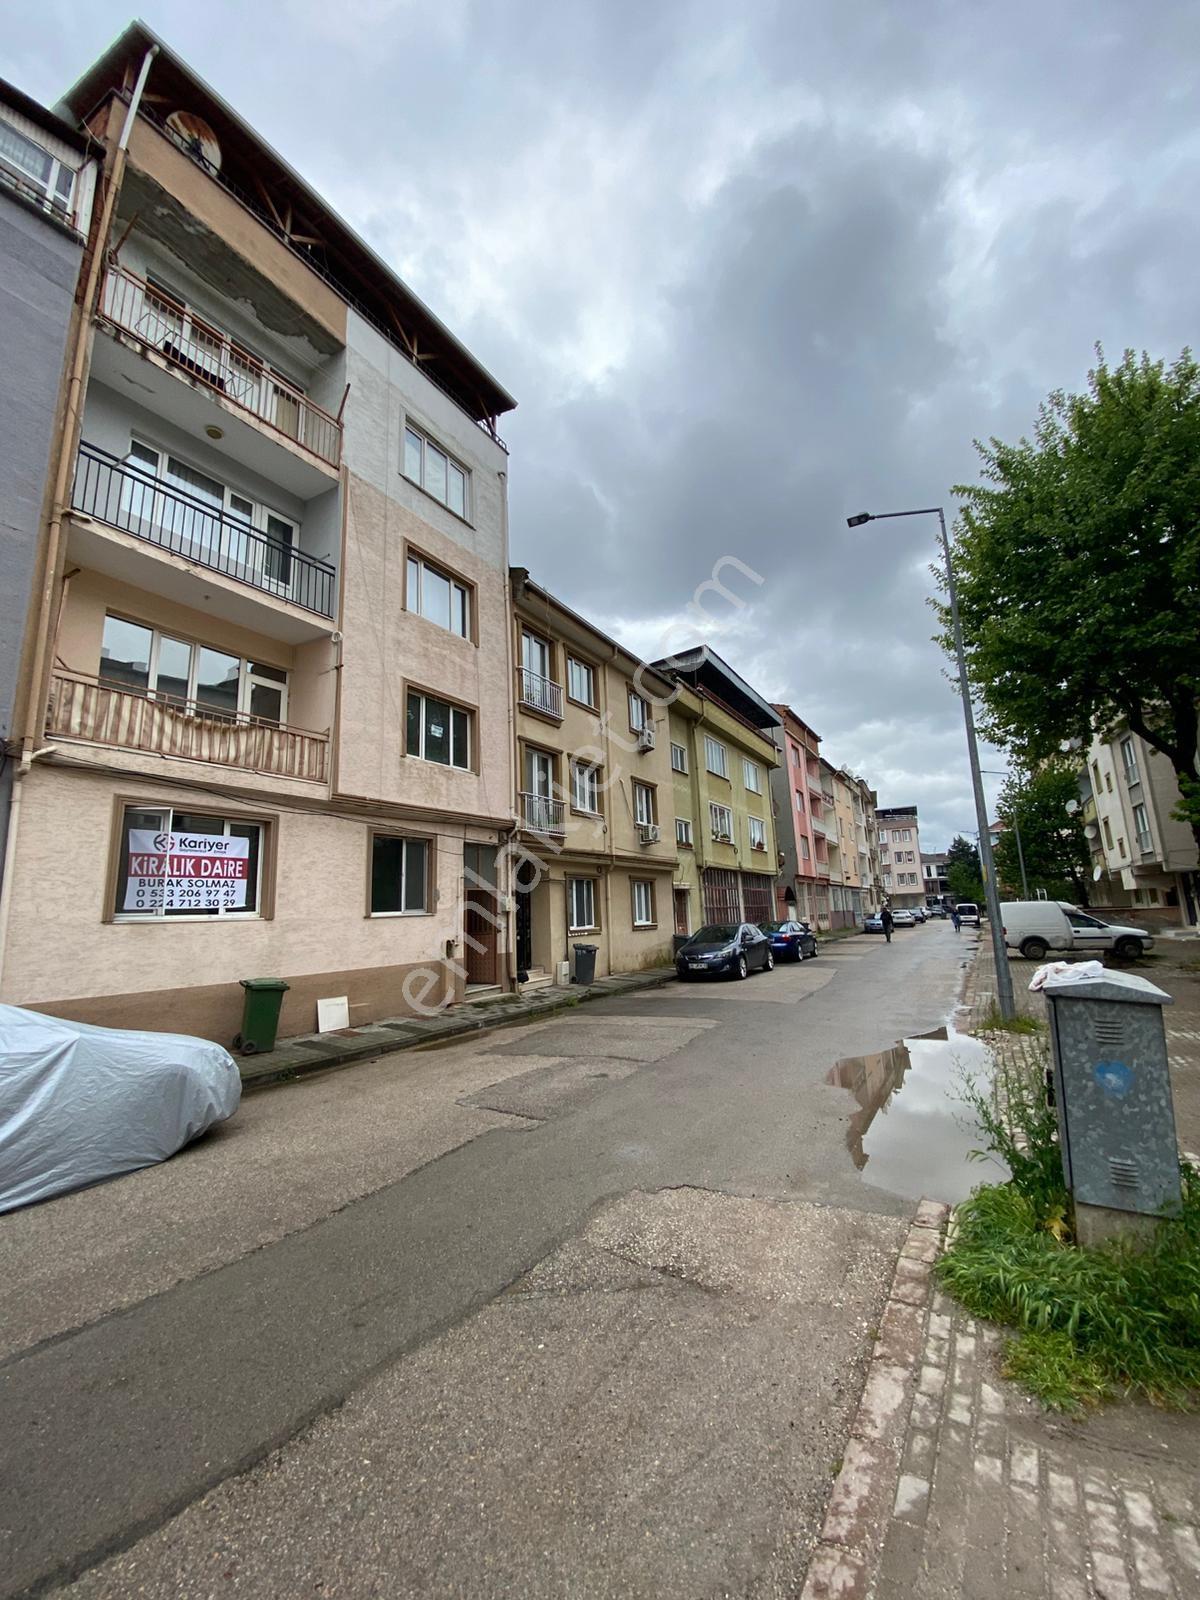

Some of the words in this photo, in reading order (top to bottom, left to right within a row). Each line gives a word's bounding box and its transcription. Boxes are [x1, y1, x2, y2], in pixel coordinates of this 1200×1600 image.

[179, 838, 230, 852] Kariyer
[138, 878, 183, 888] BURAK
[187, 879, 236, 888] SOLMAZ
[179, 889, 201, 898] 206
[206, 889, 220, 897] 97
[223, 889, 236, 897] 47
[179, 899, 201, 907] 712
[205, 899, 220, 907] 30
[223, 899, 236, 907] 29
